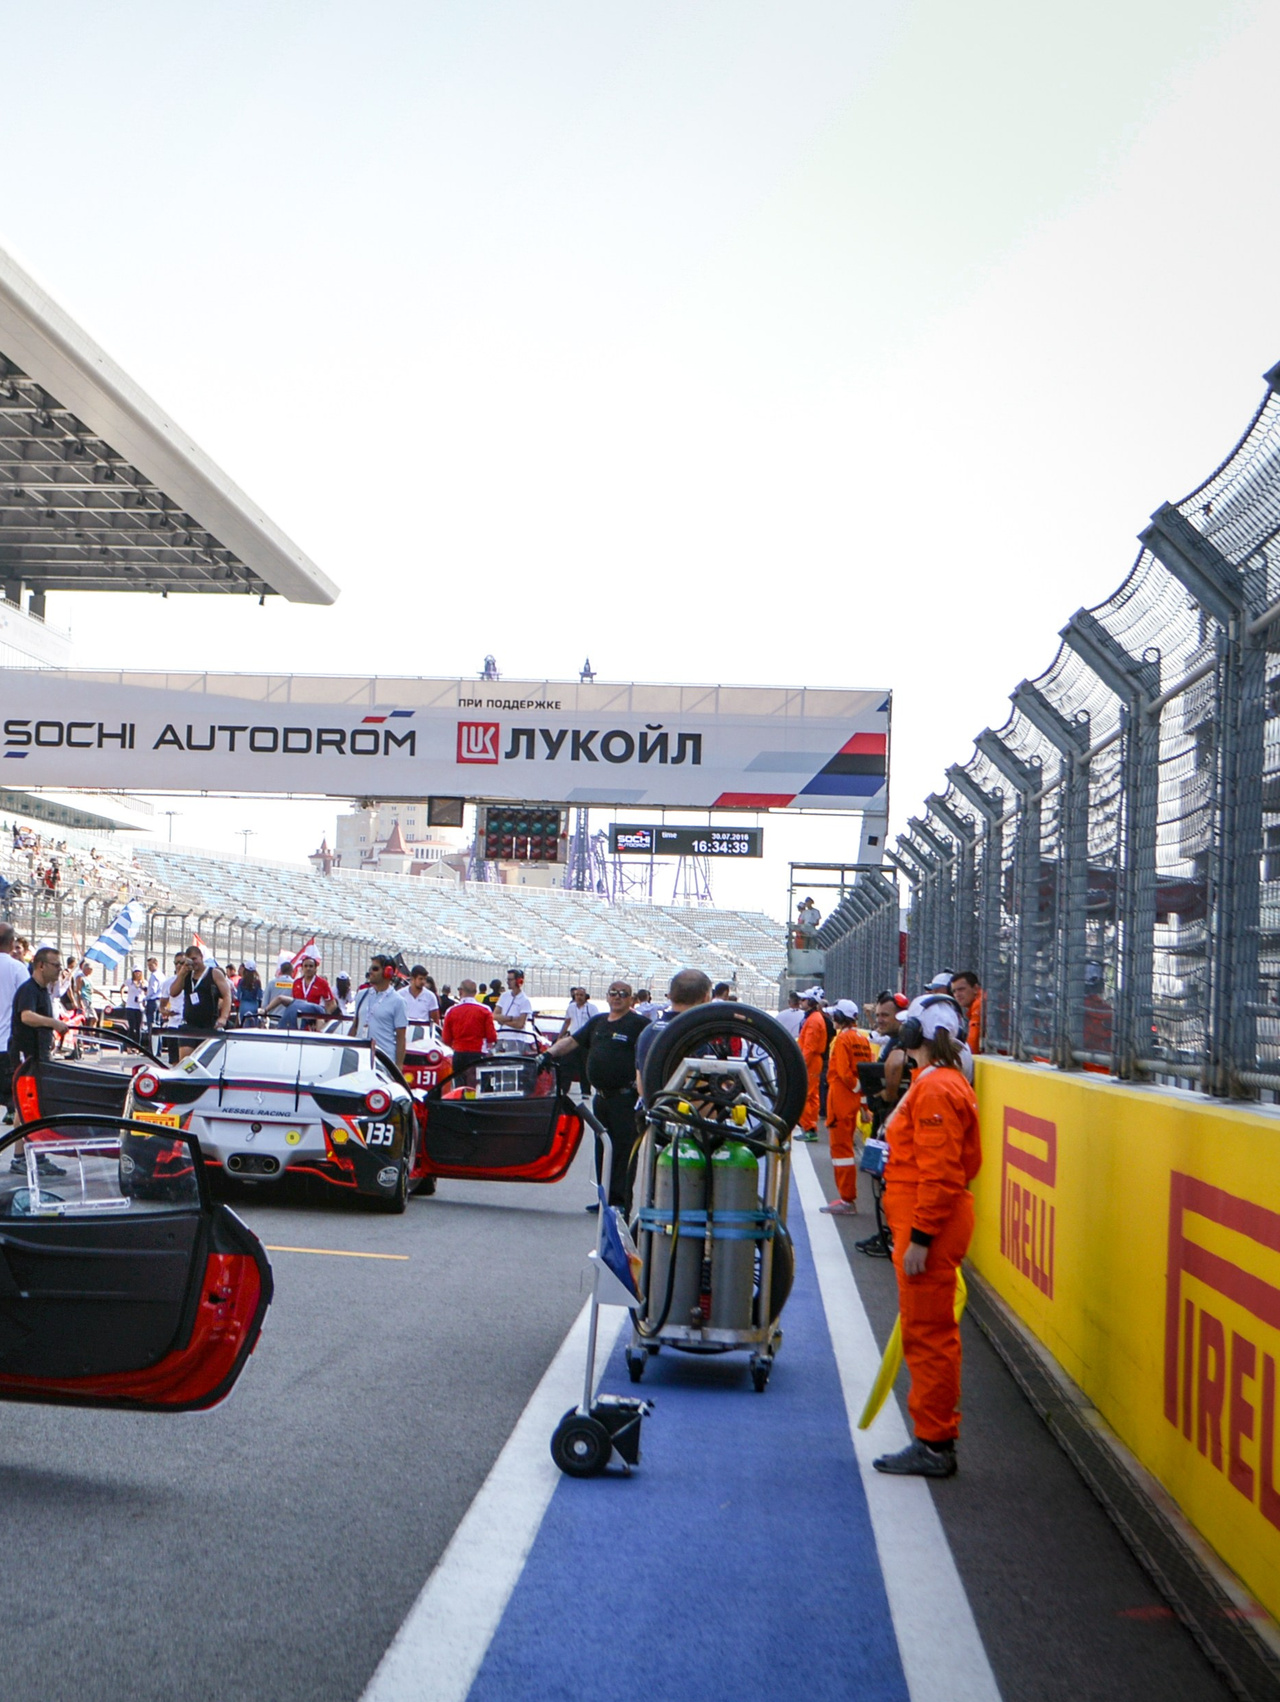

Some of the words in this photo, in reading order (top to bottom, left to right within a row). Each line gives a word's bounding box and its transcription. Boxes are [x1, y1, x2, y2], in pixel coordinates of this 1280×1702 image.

[458, 698, 483, 708] ПРИ
[486, 699, 562, 711] ПОДДЕРЖКЕ
[3, 720, 136, 749] SOCHI
[152, 723, 417, 757] AUTODROM
[504, 722, 703, 766] ЛУКОЙЛ
[617, 834, 651, 844] SOCHI
[661, 831, 678, 839] time
[692, 840, 749, 854] 16:34:39
[416, 1070, 437, 1086] 131
[221, 1107, 256, 1117] KESSEL
[257, 1109, 292, 1119] RACING
[365, 1122, 395, 1147] 133
[1000, 1104, 1057, 1301] PIRELLI
